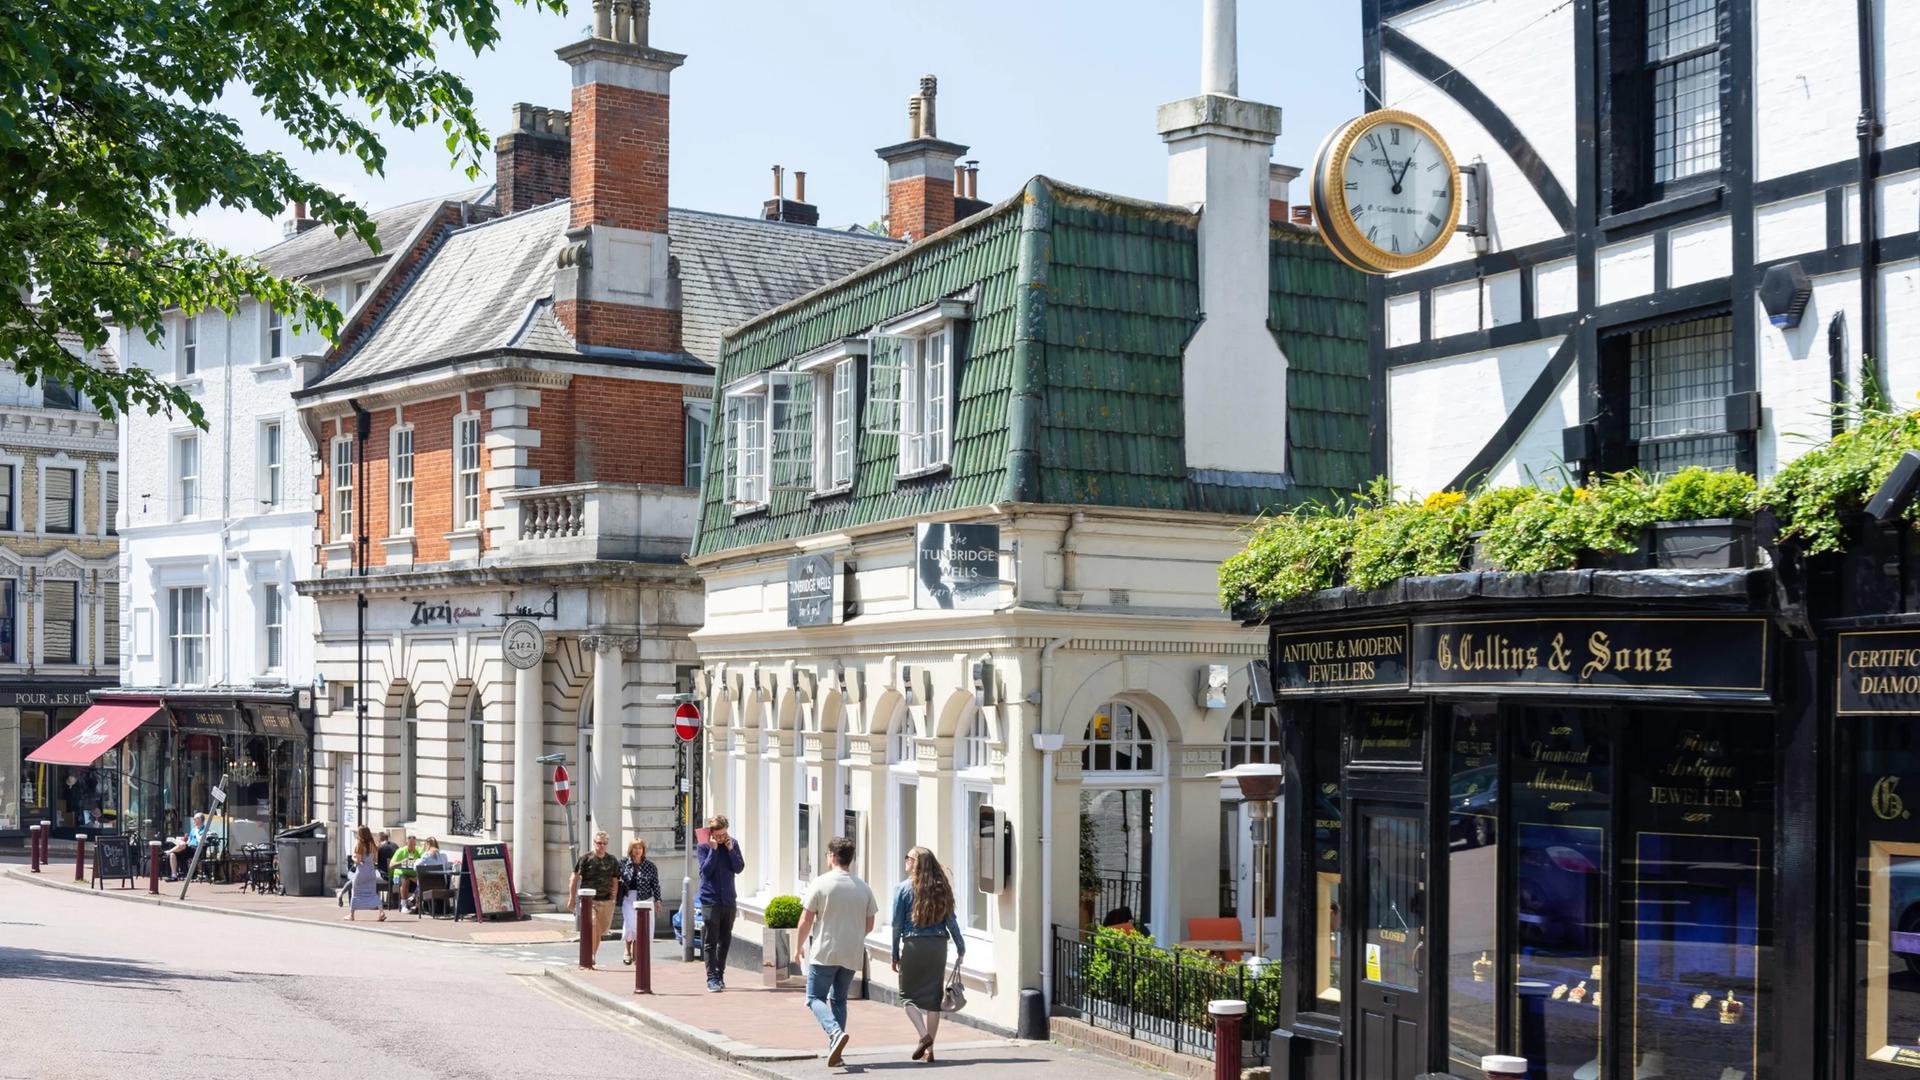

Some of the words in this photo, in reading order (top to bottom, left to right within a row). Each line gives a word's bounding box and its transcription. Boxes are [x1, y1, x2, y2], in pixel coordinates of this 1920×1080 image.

[921, 548, 996, 562] TUNBRIDGE
[940, 566, 978, 578] WELLS
[789, 578, 816, 594] TUNBRIDGE
[816, 575, 832, 590] WELLS
[410, 600, 452, 626] Zizzi
[508, 639, 536, 650] Zizzi
[1283, 640, 1334, 663] ANTIQUE
[1336, 639, 1345, 659] &
[1348, 635, 1402, 657] MODERN
[1548, 632, 1572, 671] &
[1581, 630, 1673, 679] Sons
[1307, 660, 1376, 683] JEWELLERS
[15, 693, 47, 704] POUR
[50, 693, 70, 704] LES
[1531, 740, 1590, 763] Diamond
[1527, 768, 1593, 792] Merchants
[476, 847, 499, 856] Zizzi
[1380, 929, 1407, 943] CLOSED
